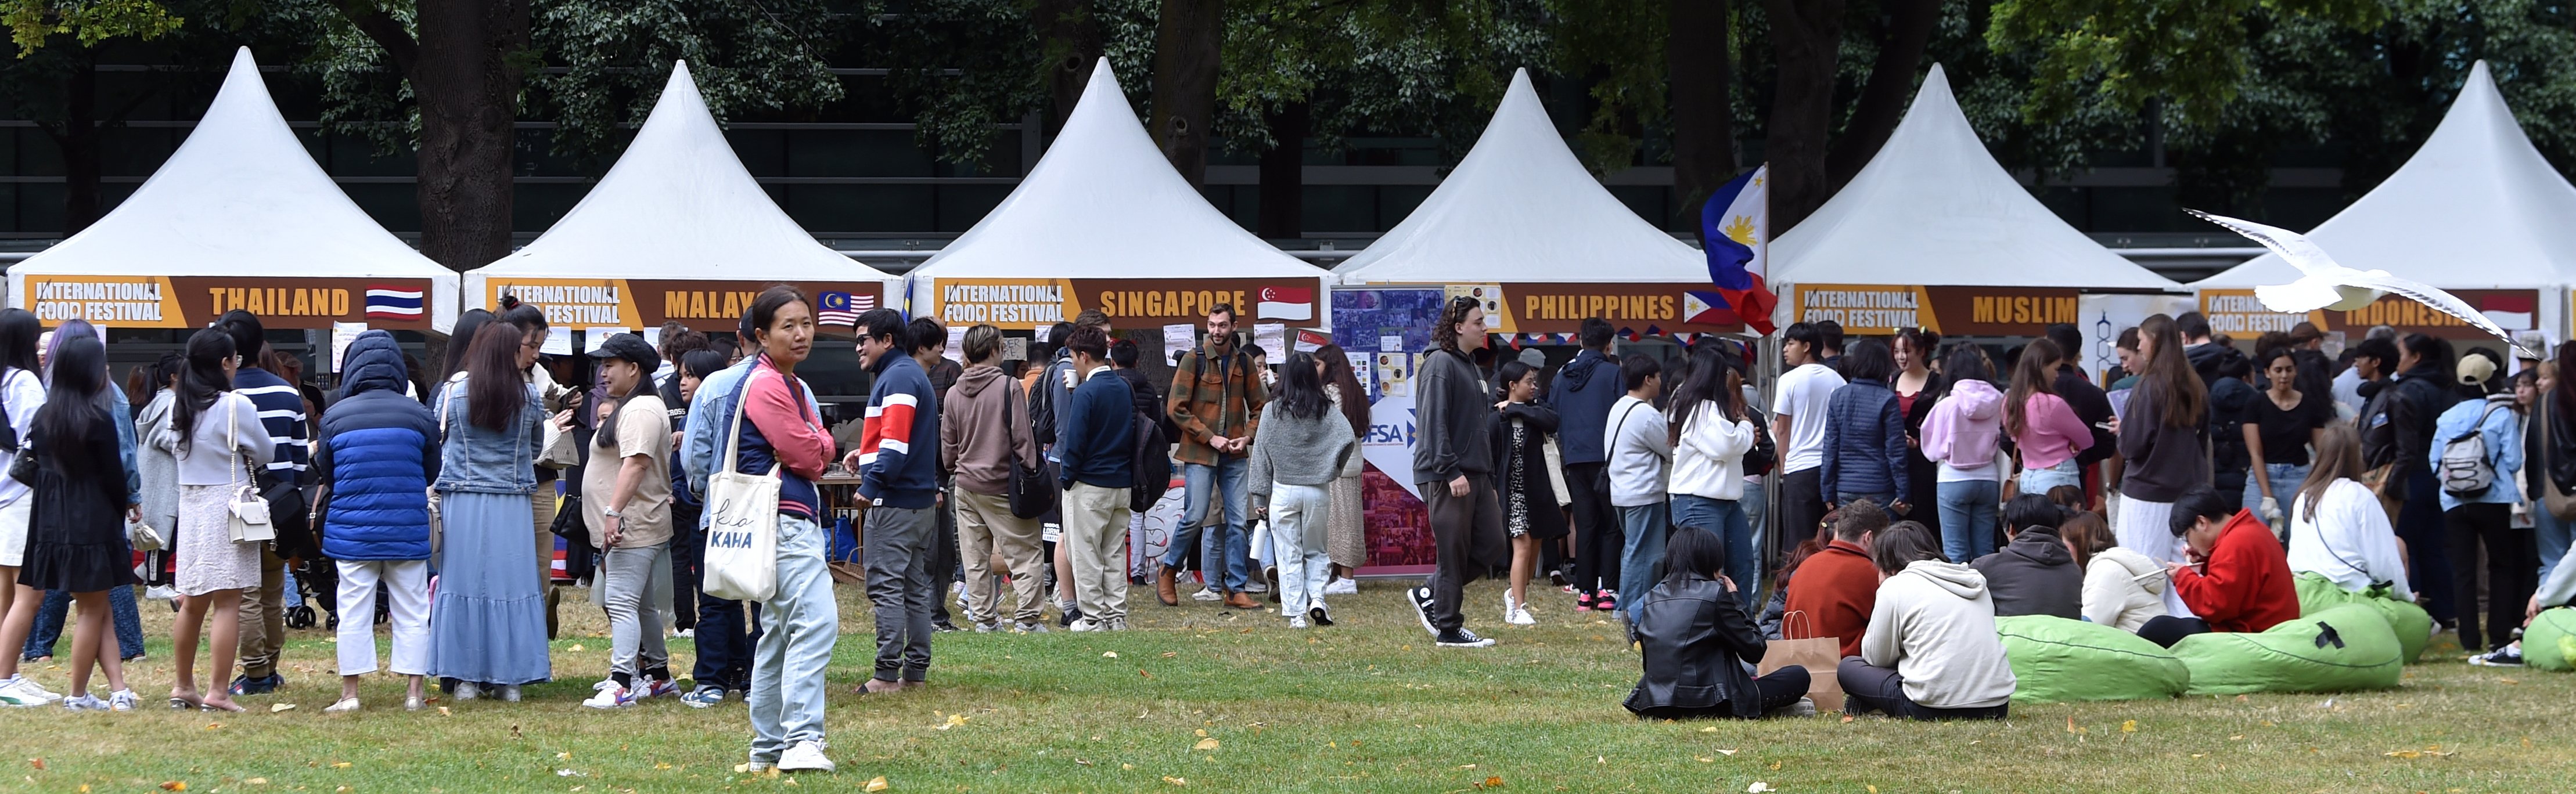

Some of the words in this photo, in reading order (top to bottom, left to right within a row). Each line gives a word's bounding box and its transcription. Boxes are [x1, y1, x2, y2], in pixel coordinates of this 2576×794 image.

[36, 282, 163, 301] INTERNATIONAL
[944, 285, 1064, 303] INTERNATIONAL
[1804, 290, 1919, 309] INTERNATIONAL
[35, 301, 81, 320] FOOD
[85, 302, 163, 321] FESTIVAL
[209, 287, 350, 316] THAILAND
[665, 291, 765, 319] MALAY
[1100, 290, 1246, 317] SINGAPORE
[1525, 295, 1675, 320] PHILIPPINES
[1973, 296, 2077, 324] MUSLIM
[2208, 295, 2270, 312] INTERNA
[545, 305, 621, 324] FESTIVAL
[944, 304, 987, 322] FOOD
[991, 304, 1064, 322] FESTIVAL
[1804, 308, 1845, 327] FOOD
[1848, 309, 1919, 328] FESTIVAL
[2208, 313, 2245, 332] FOOD
[1003, 339, 1021, 348] DER
[712, 498, 754, 529] kia
[710, 530, 752, 549] KAHA
